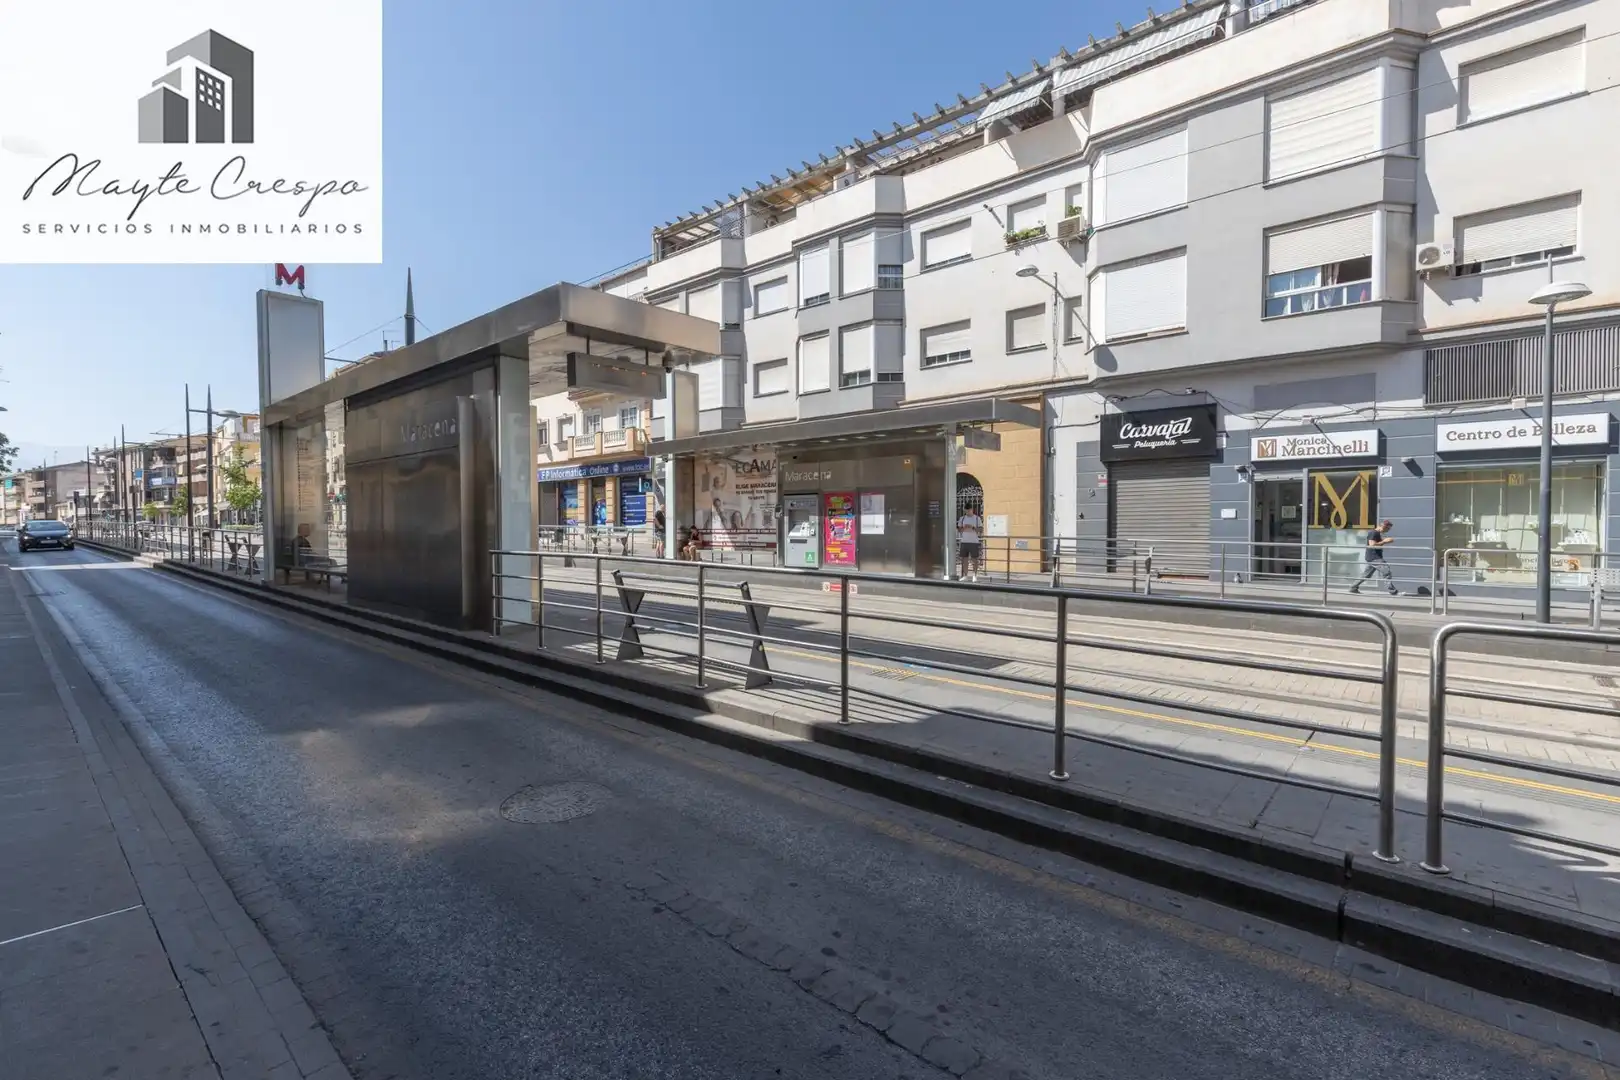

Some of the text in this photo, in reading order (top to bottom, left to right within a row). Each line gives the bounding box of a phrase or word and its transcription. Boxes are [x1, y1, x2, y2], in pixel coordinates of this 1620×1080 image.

[275, 263, 305, 286] M
[401, 419, 456, 442] Maracena
[1120, 417, 1192, 439] Carvajal
[1446, 422, 1597, 442] Centro de Blleza
[1281, 440, 1369, 457] Mancinelli
[1286, 437, 1327, 447] Monica
[589, 465, 609, 475] Online
[785, 471, 832, 482] Maracena
[1309, 471, 1376, 529] M
